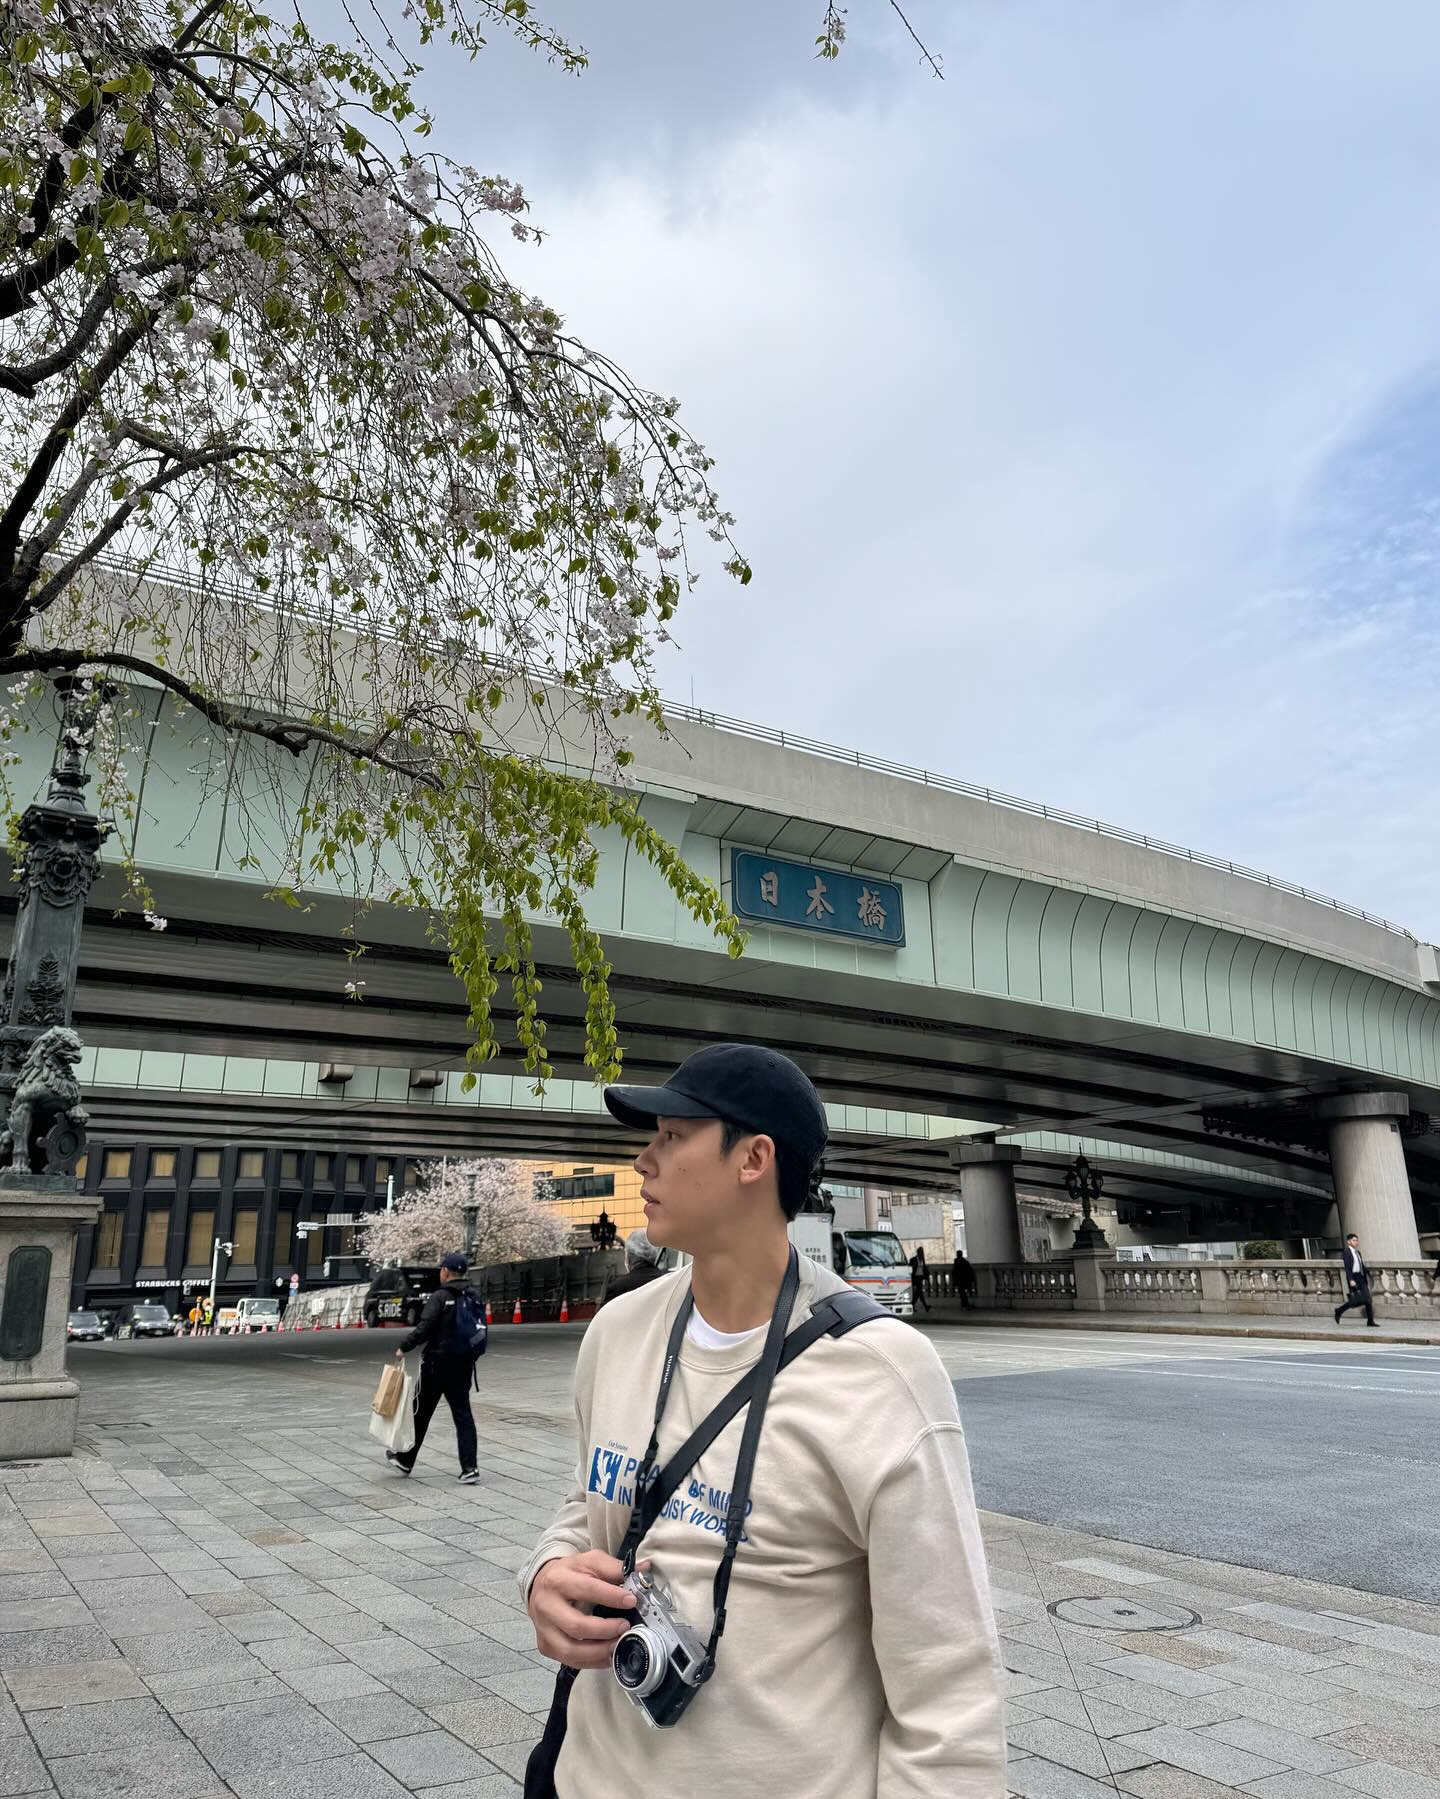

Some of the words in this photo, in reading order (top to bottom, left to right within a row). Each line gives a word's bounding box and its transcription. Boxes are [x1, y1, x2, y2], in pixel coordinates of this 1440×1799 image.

[760, 871, 887, 930] 日本橋
[136, 1280, 180, 1288] STARBUCKS
[618, 1486, 632, 1506] IN
